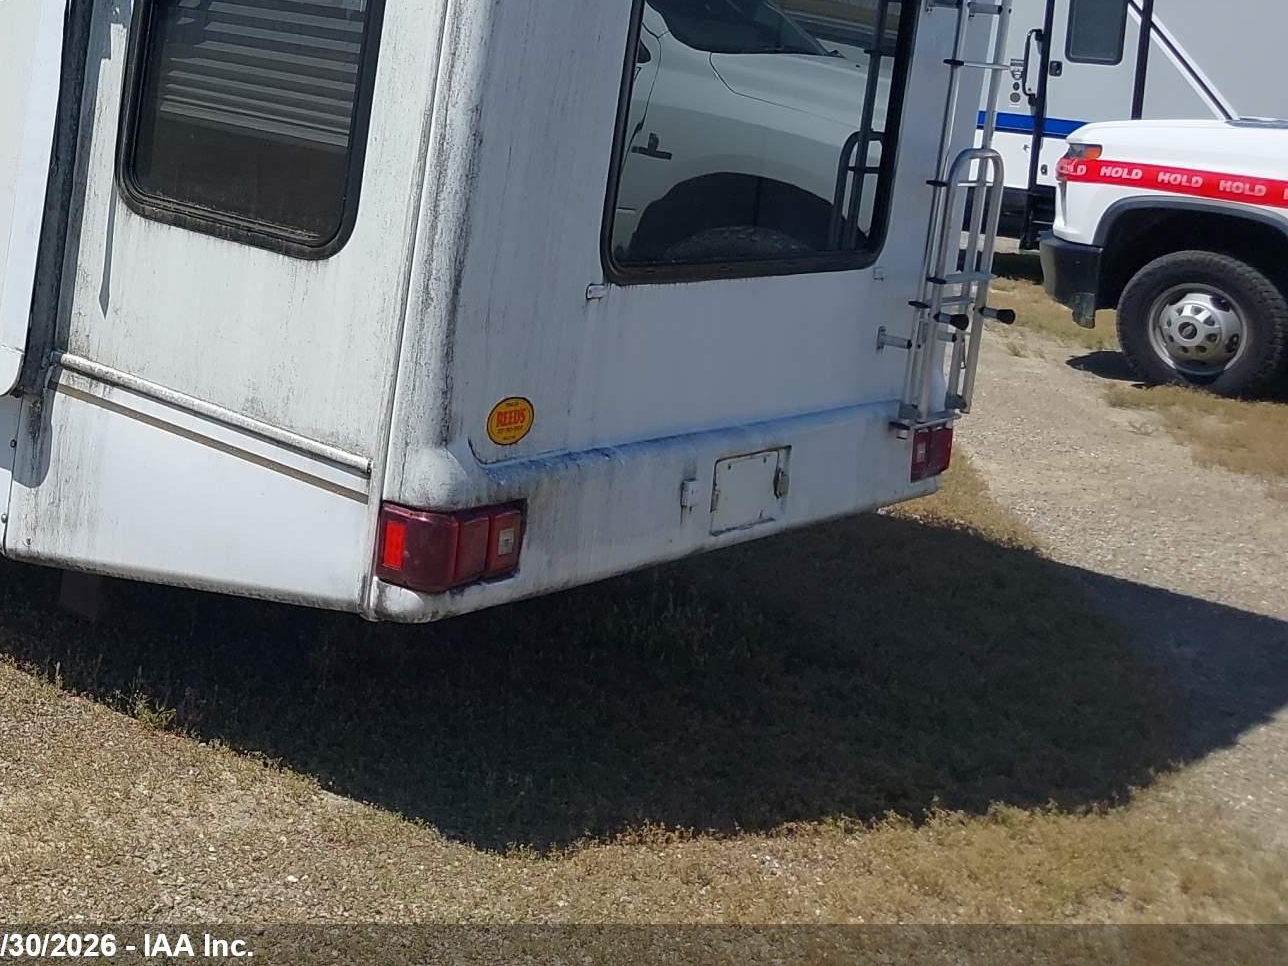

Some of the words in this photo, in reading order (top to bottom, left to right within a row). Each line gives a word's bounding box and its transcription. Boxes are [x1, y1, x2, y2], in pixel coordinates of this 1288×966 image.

[1100, 165, 1143, 180] HOLD
[1157, 171, 1204, 188] HOLD
[1219, 179, 1267, 197] HOLD
